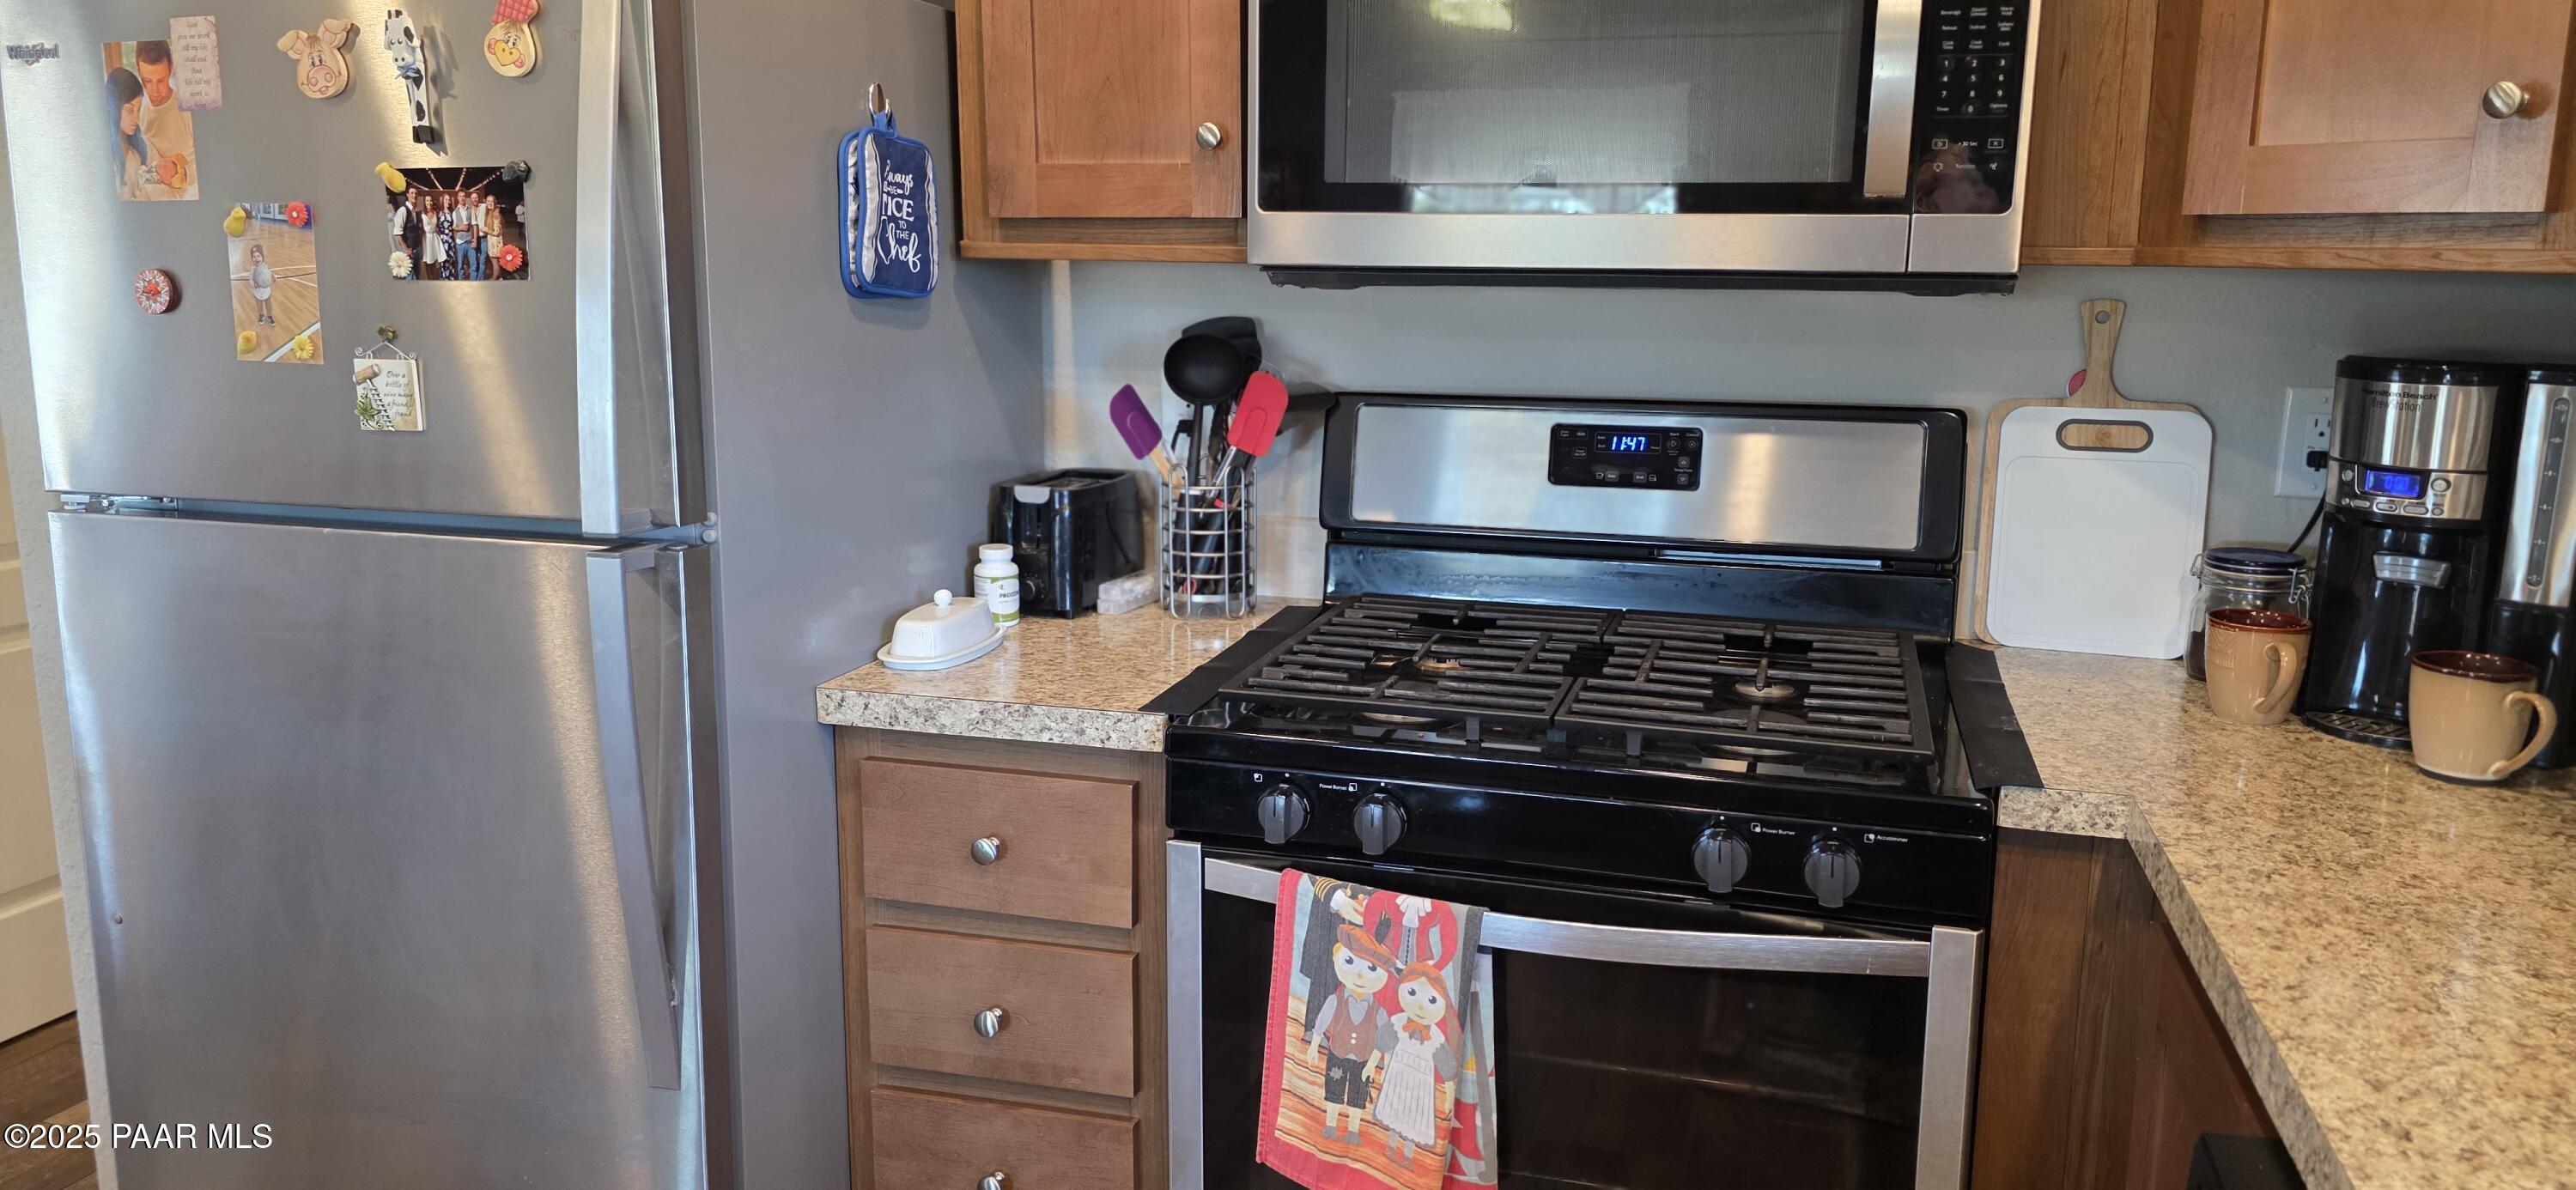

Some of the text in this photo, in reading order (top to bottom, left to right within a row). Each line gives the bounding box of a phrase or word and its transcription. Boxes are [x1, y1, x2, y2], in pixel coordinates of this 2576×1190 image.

[899, 220, 907, 229] TO
[896, 229, 910, 240] THE
[2362, 387, 2437, 401] Hamilton Beach
[1611, 436, 1646, 452] 11:47
